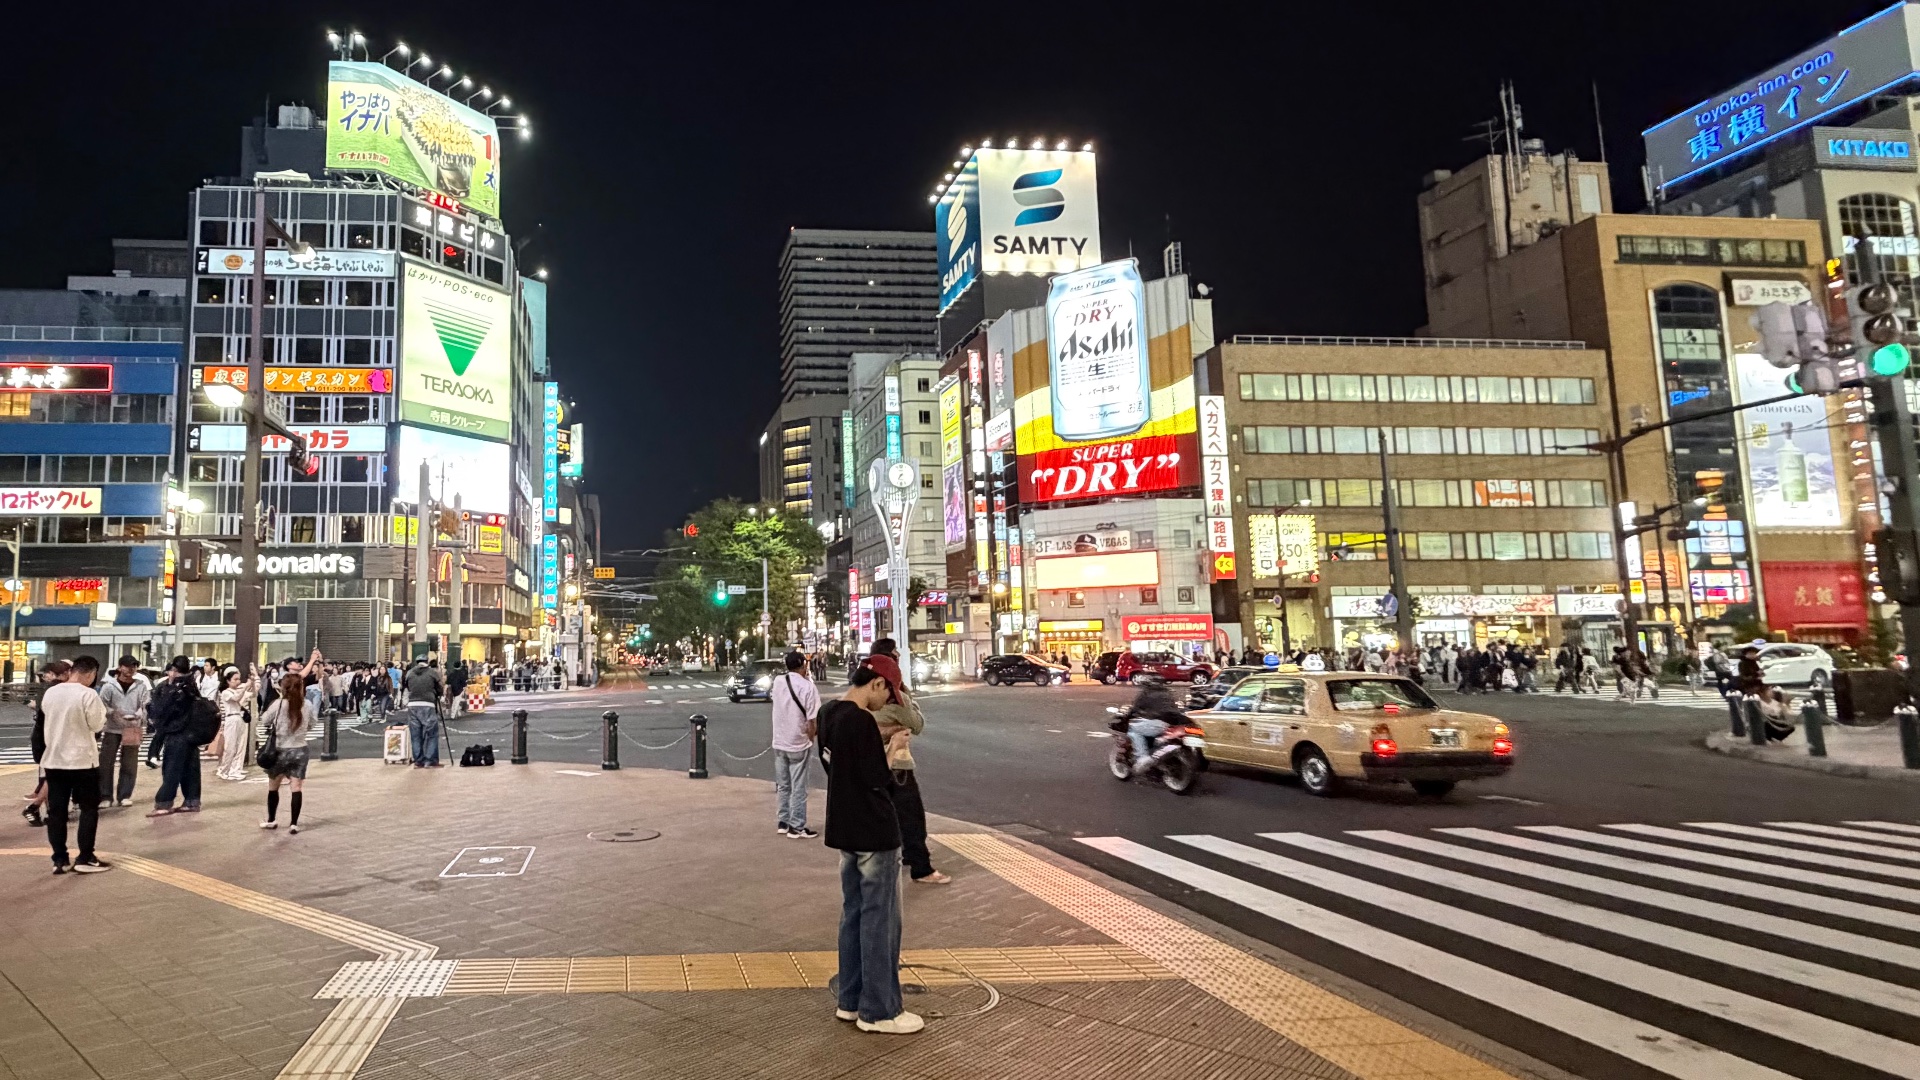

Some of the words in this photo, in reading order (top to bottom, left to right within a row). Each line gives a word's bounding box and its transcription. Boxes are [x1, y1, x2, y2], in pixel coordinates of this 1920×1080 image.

[1695, 51, 1834, 127] toyoko-inn.com
[340, 90, 390, 111] やっぱり
[339, 111, 392, 135] イナバ
[1688, 69, 1849, 162] 東横イン
[1828, 138, 1910, 158] KITAKO
[993, 235, 1088, 255] SAMTY
[942, 241, 976, 295] SAMTY
[1059, 318, 1133, 362] Asahi
[1088, 362, 1106, 377] 生
[420, 374, 494, 404] TERAOKA
[1793, 404, 1813, 413] GIN
[429, 410, 486, 431] 寺岡グループ
[1071, 442, 1134, 463] SUPER
[1035, 540, 1052, 553] 3F
[1055, 540, 1073, 551] LAS
[1099, 536, 1128, 548] VEGAS
[206, 553, 356, 574] McDonald's
